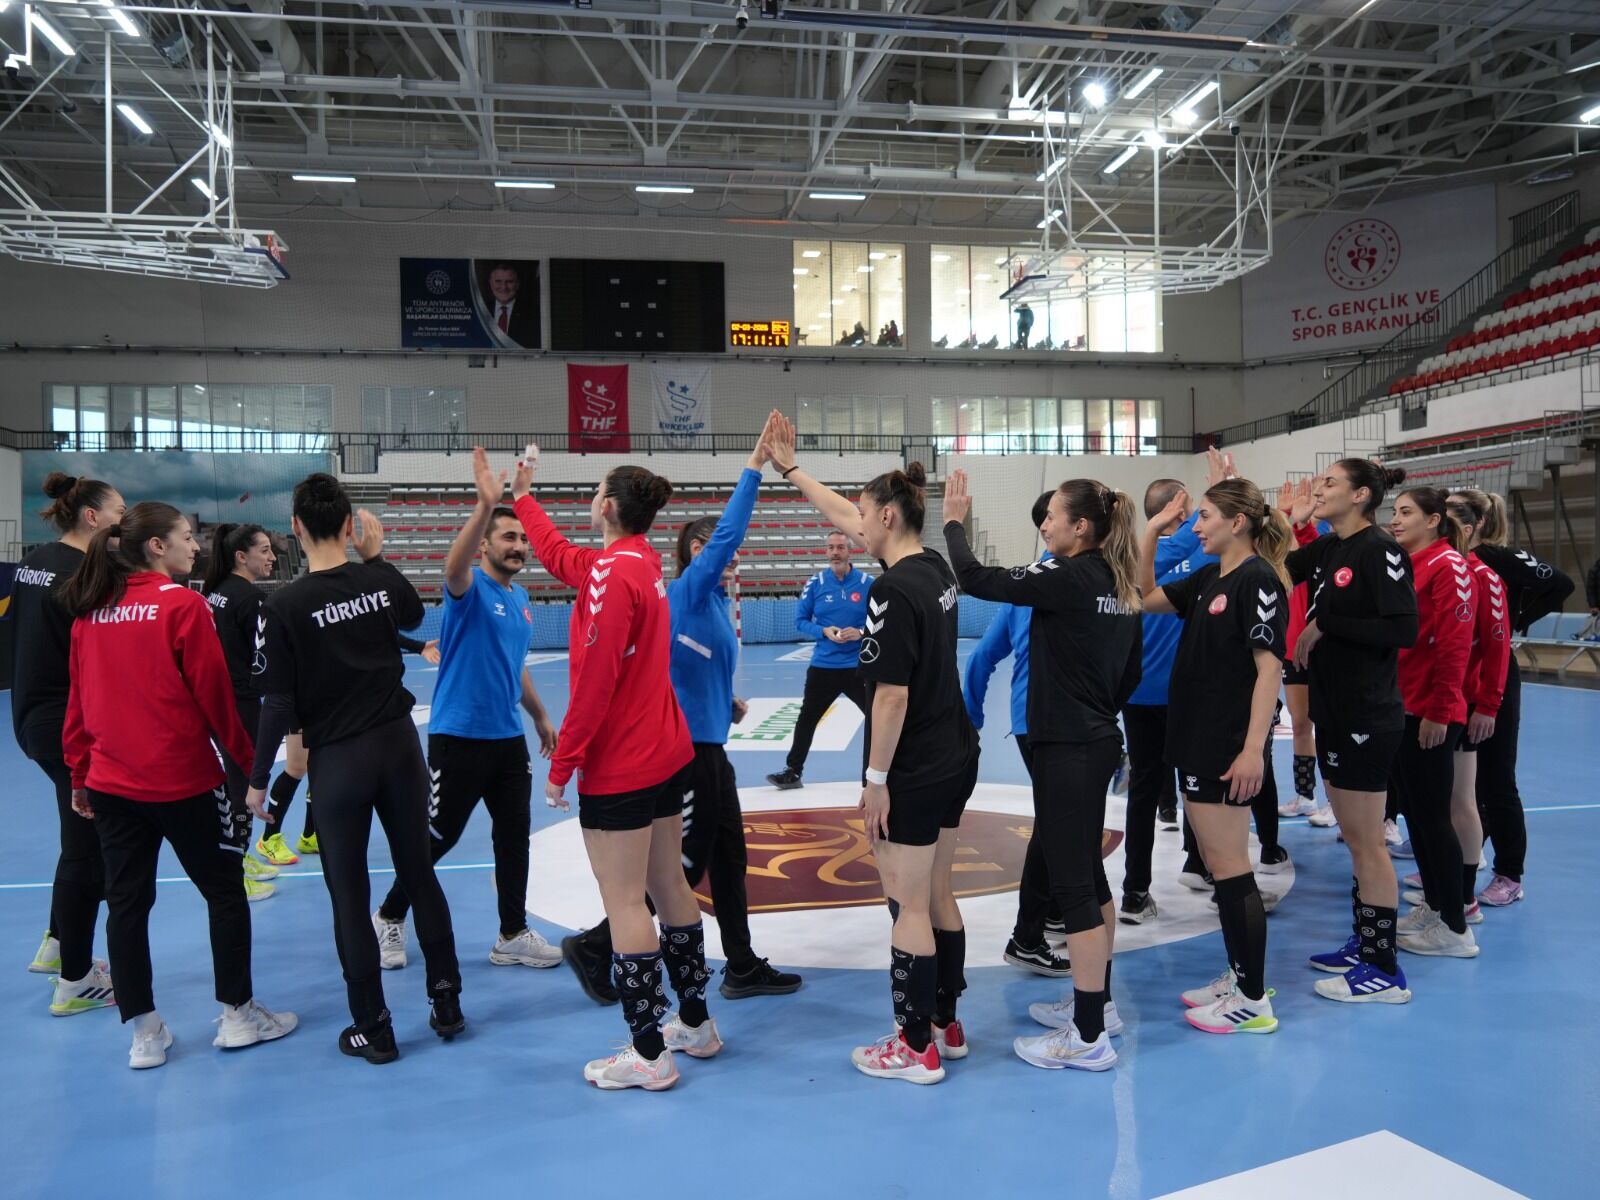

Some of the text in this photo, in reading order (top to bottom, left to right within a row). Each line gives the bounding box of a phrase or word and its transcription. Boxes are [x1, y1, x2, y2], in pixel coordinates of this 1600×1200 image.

[1291, 289, 1440, 322] T.C. GENÇLİK VE
[1292, 307, 1440, 341] SPOR BAKANLIĞI
[732, 334, 789, 346] 17:11:17
[581, 416, 617, 430] THF
[14, 565, 56, 587] TÜRKİYE
[91, 602, 159, 625] TÜRKİYE
[311, 590, 391, 628] TÜRKİYE
